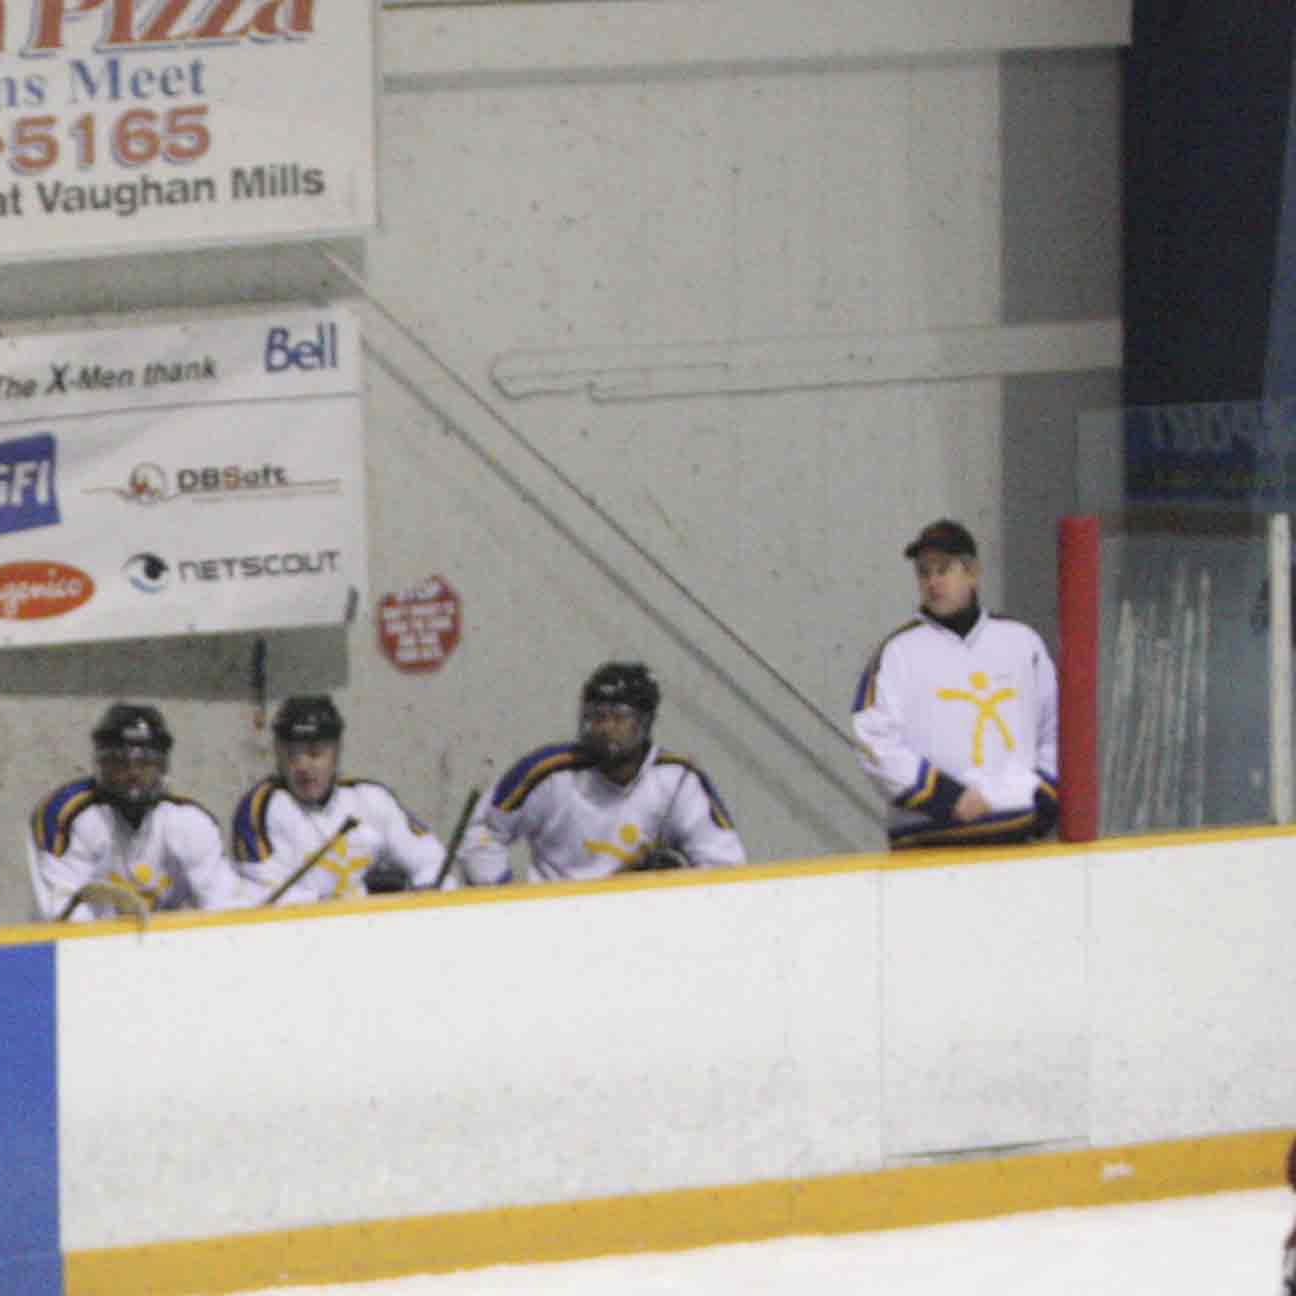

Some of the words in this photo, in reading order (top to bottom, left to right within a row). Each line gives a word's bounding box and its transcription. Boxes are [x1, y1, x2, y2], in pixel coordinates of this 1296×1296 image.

[69, 57, 207, 105] Meet
[36, 173, 215, 217] Vaughan
[230, 162, 326, 200] Mills
[264, 321, 338, 374] Bell
[46, 363, 135, 396] X-Men
[142, 356, 218, 387] thank
